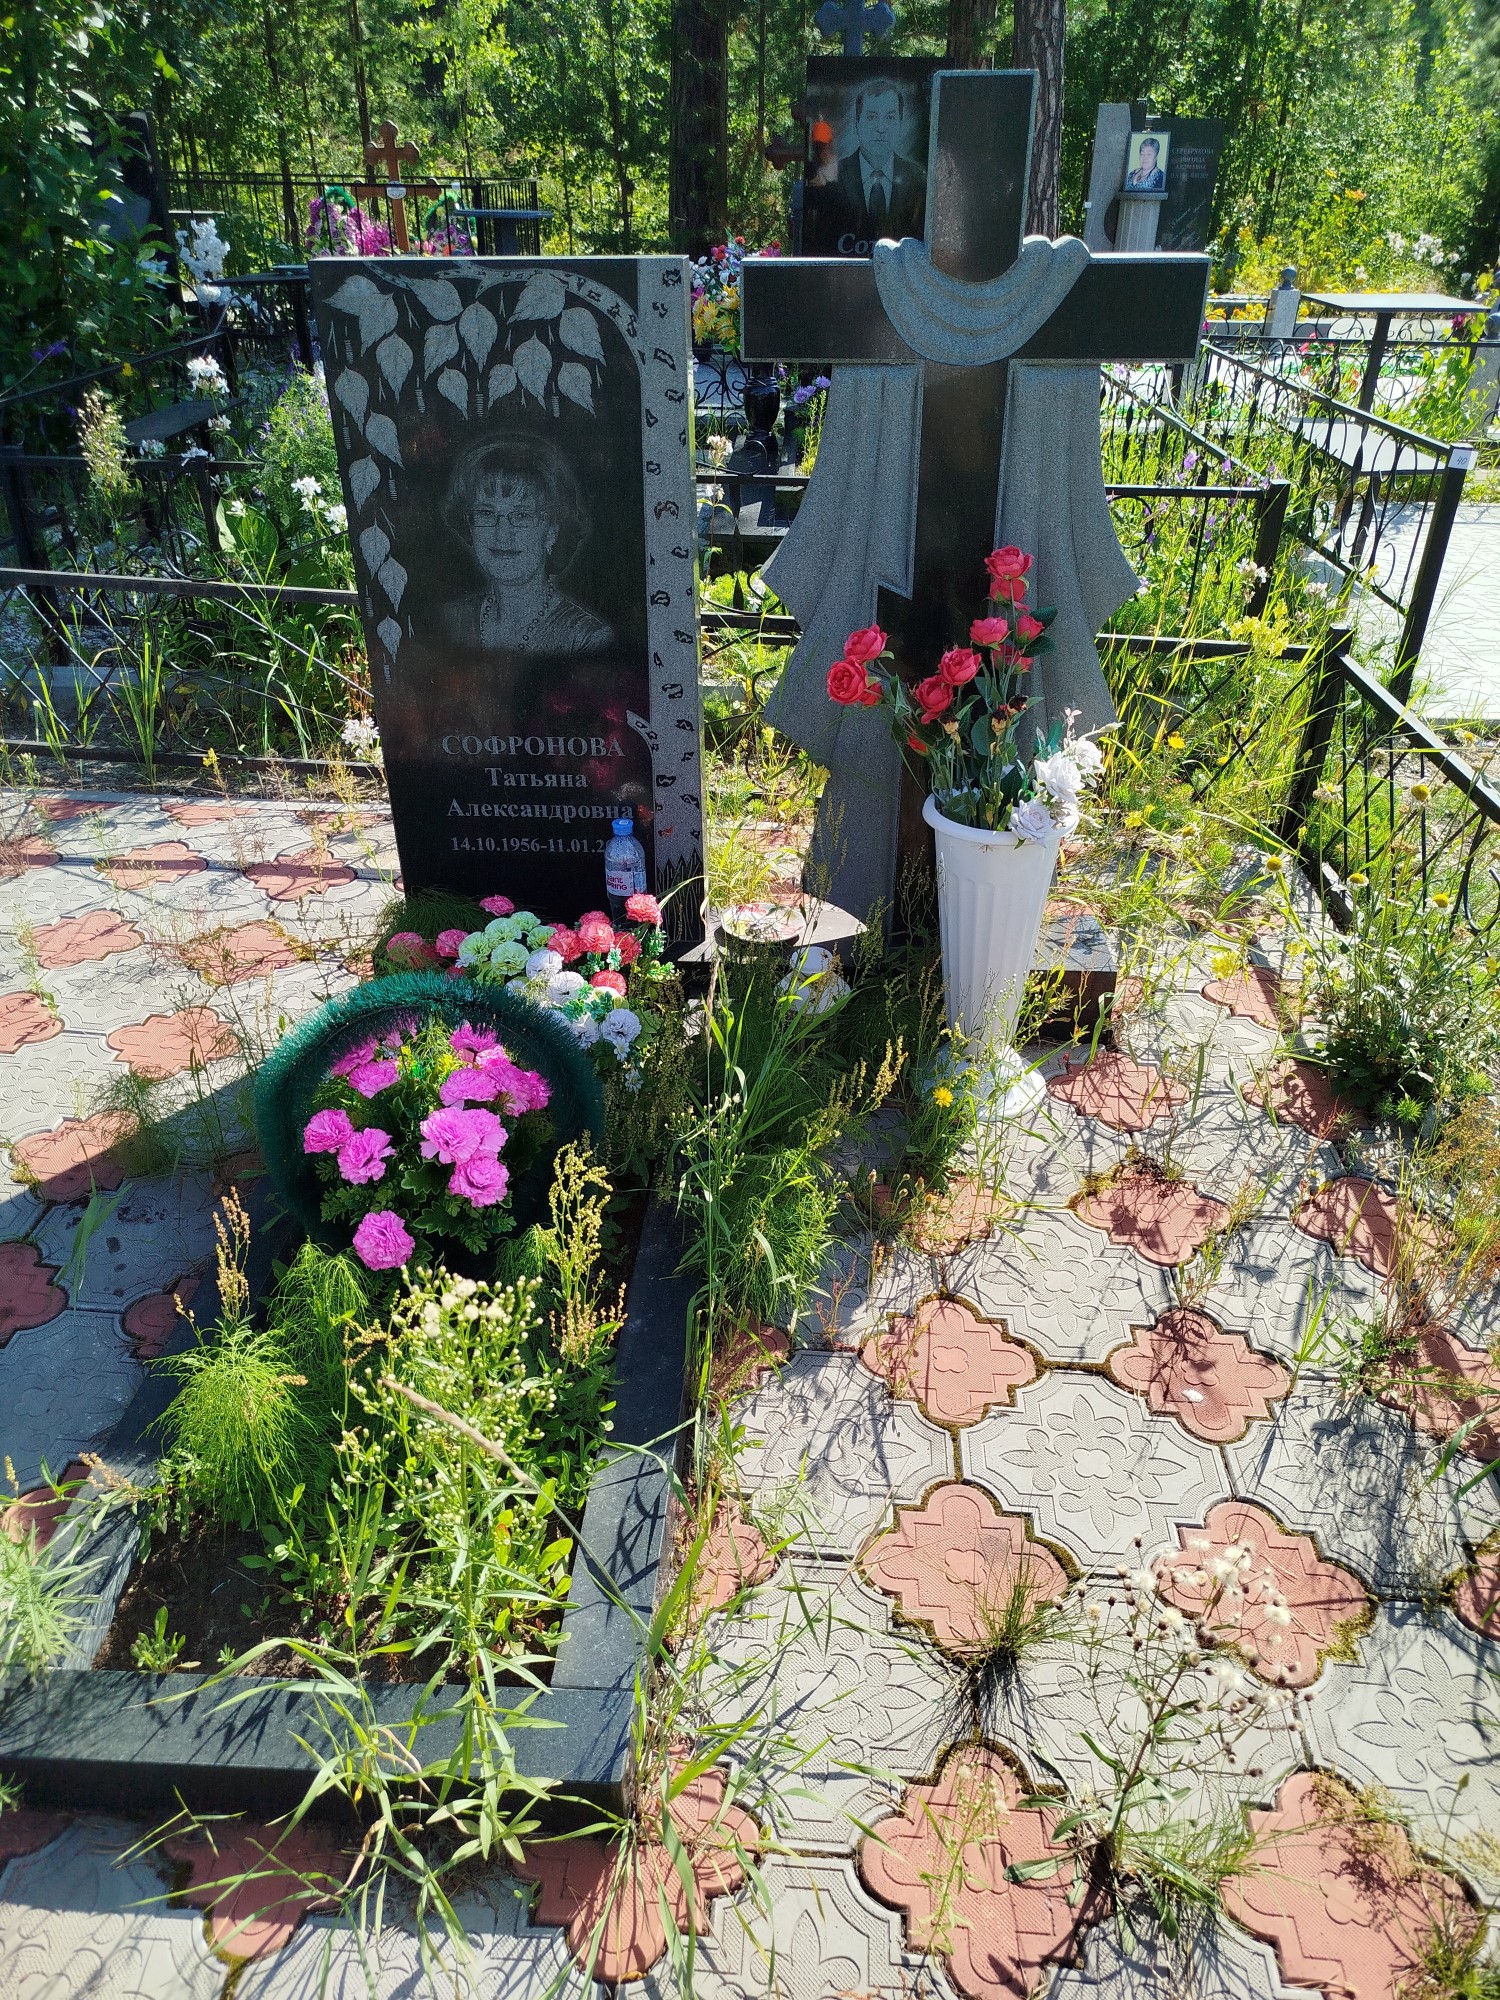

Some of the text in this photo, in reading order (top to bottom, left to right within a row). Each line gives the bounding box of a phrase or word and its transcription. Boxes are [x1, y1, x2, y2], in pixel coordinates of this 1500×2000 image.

[1457, 456, 1468, 465] 40
[441, 735, 626, 758] СОФРОНОВА
[484, 767, 589, 789] Татьяна
[447, 798, 634, 823] Александровна
[450, 836, 608, 854] 14.10.1956-11.01.2
